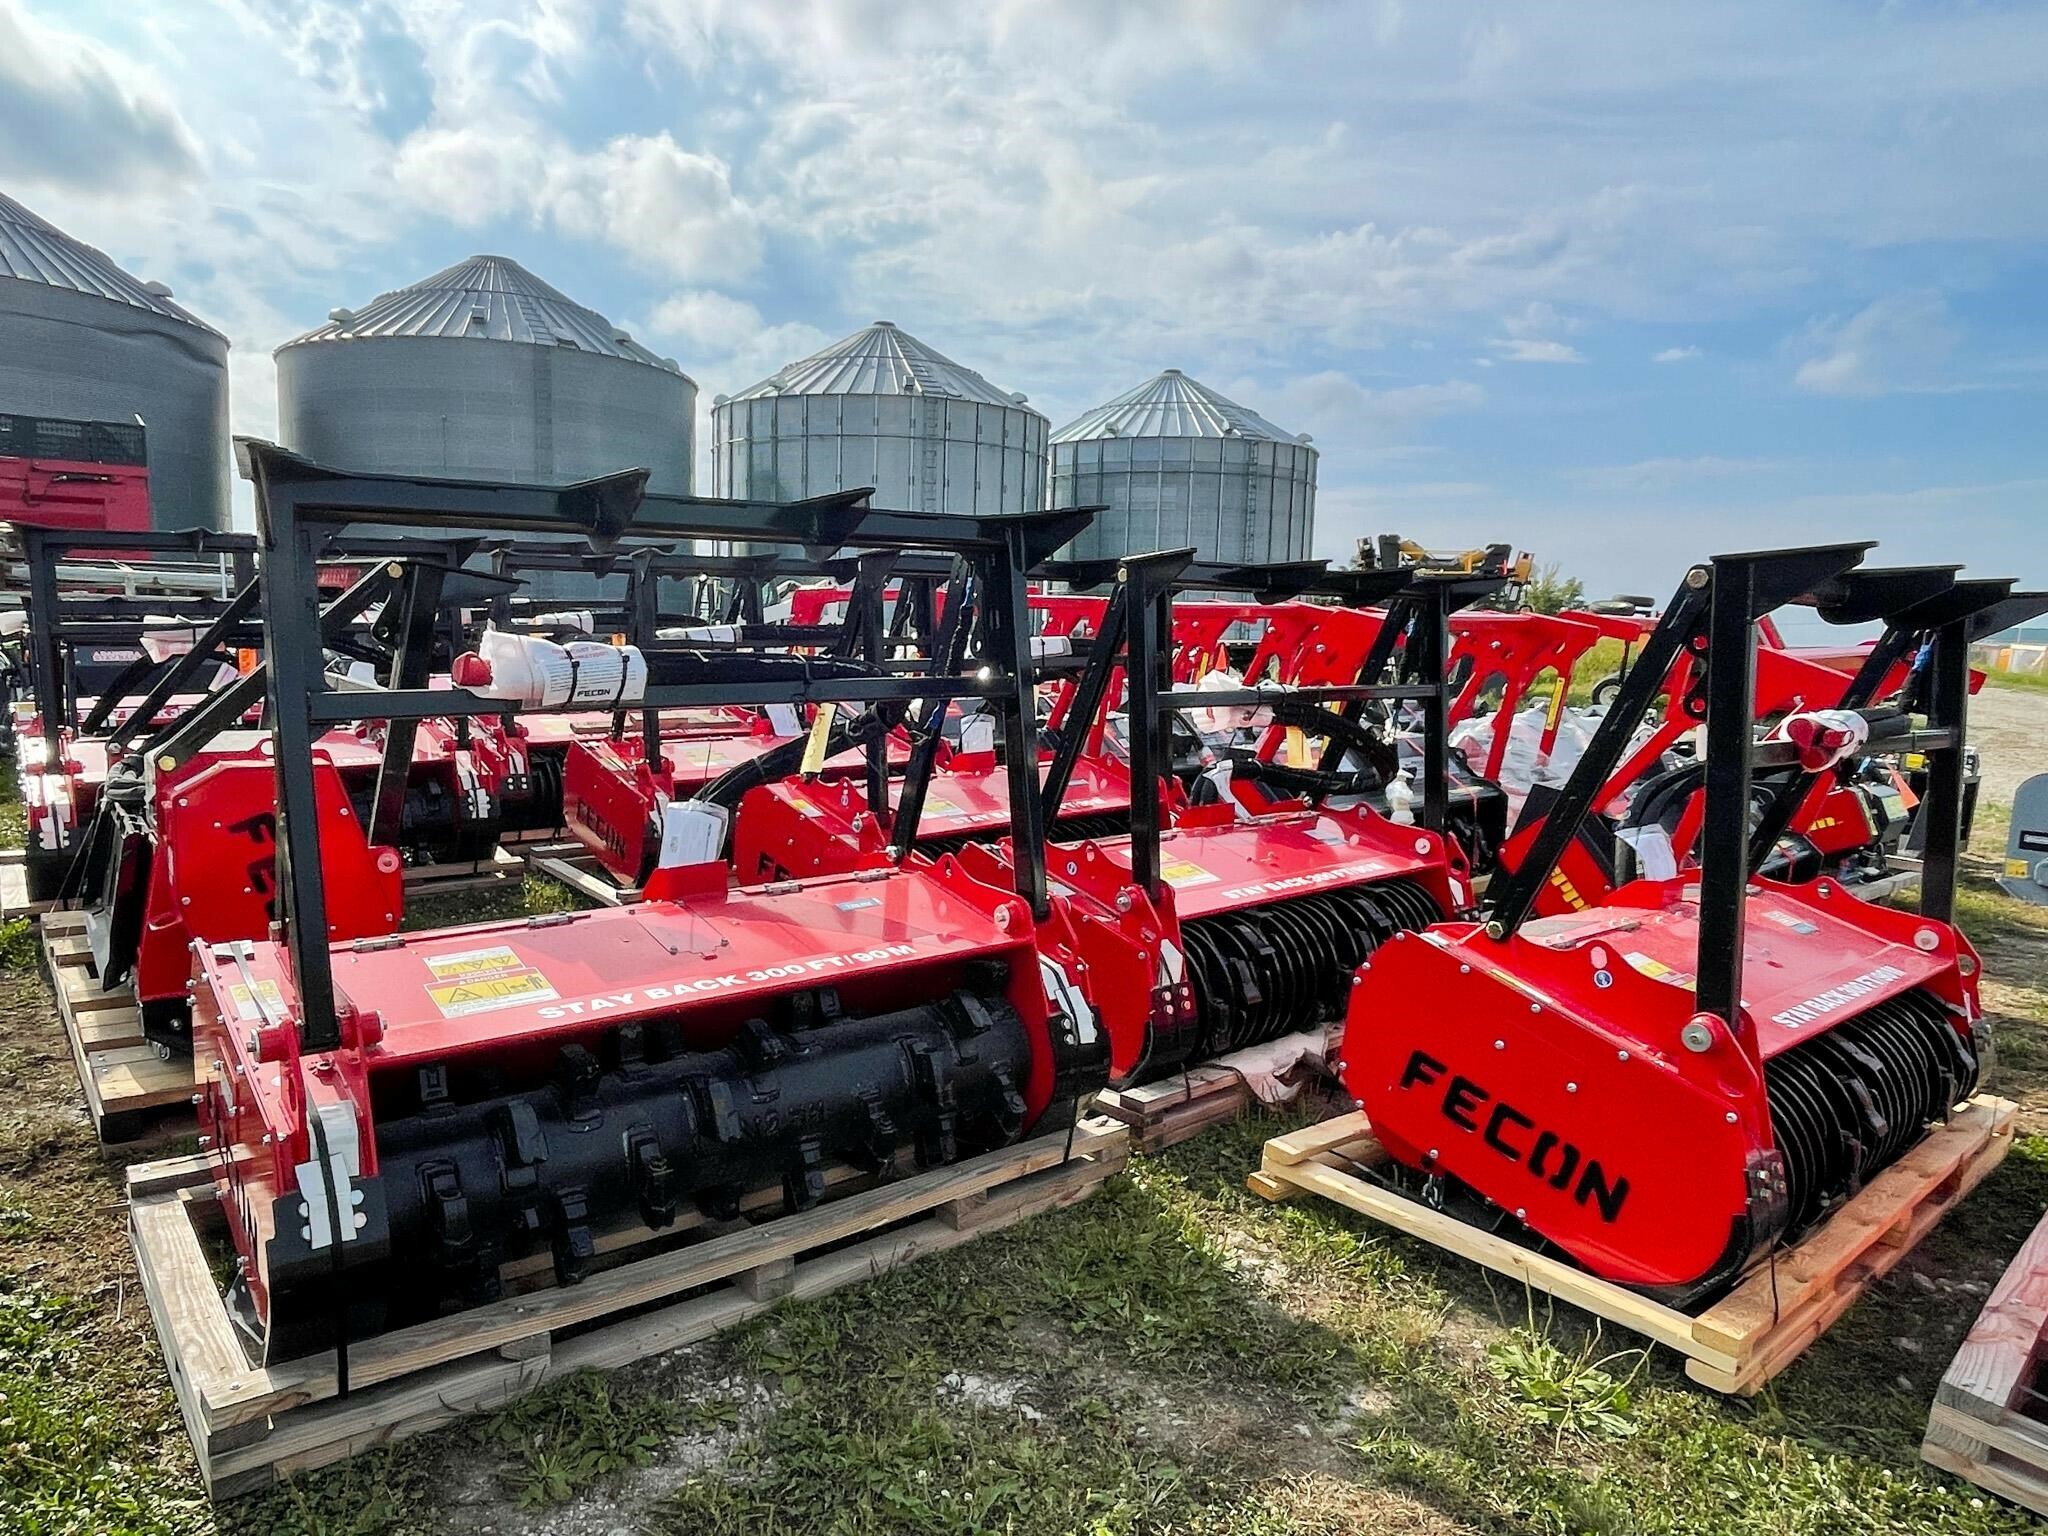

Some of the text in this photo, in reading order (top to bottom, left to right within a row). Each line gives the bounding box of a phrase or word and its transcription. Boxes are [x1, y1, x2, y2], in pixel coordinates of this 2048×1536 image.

[577, 688, 611, 697] FECON
[1222, 884, 1267, 899] STAY
[537, 993, 635, 1019] STAY
[643, 974, 747, 1000] BACK
[746, 964, 807, 982] 300
[1771, 1003, 1820, 1029] STAY
[1807, 990, 1847, 1013] BACK
[1399, 1050, 1630, 1224] FECON
